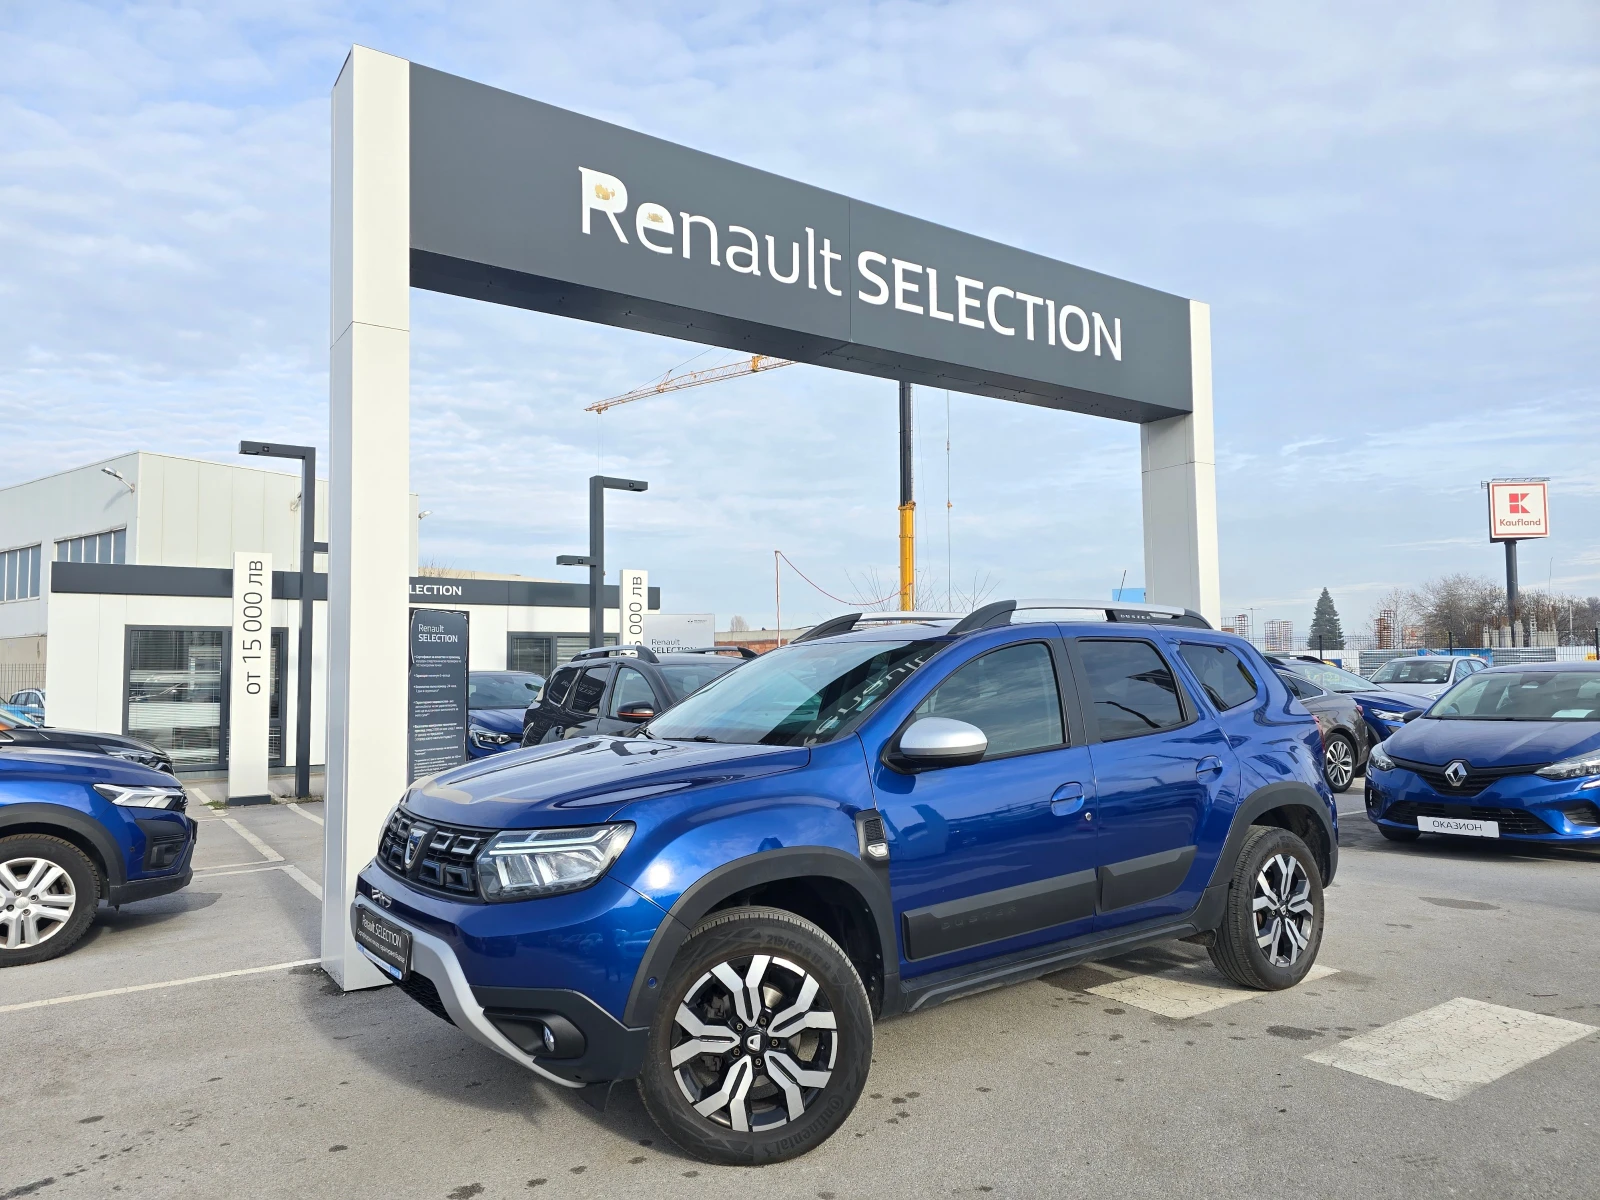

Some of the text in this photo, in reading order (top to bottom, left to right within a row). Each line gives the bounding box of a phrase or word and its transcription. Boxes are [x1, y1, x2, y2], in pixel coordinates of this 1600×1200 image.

[578, 166, 1121, 361] Renault SELECTION
[1500, 518, 1541, 526] Kaufland
[409, 584, 462, 596] LECTION
[243, 592, 262, 632] 000
[629, 602, 642, 635] 000
[418, 624, 445, 633] Renault
[418, 634, 458, 642] SELECTION
[242, 639, 262, 663] 15
[1432, 820, 1483, 831] ОКАЗИОН
[376, 923, 402, 948] SELECTION
[776, 1094, 844, 1155] Continental
